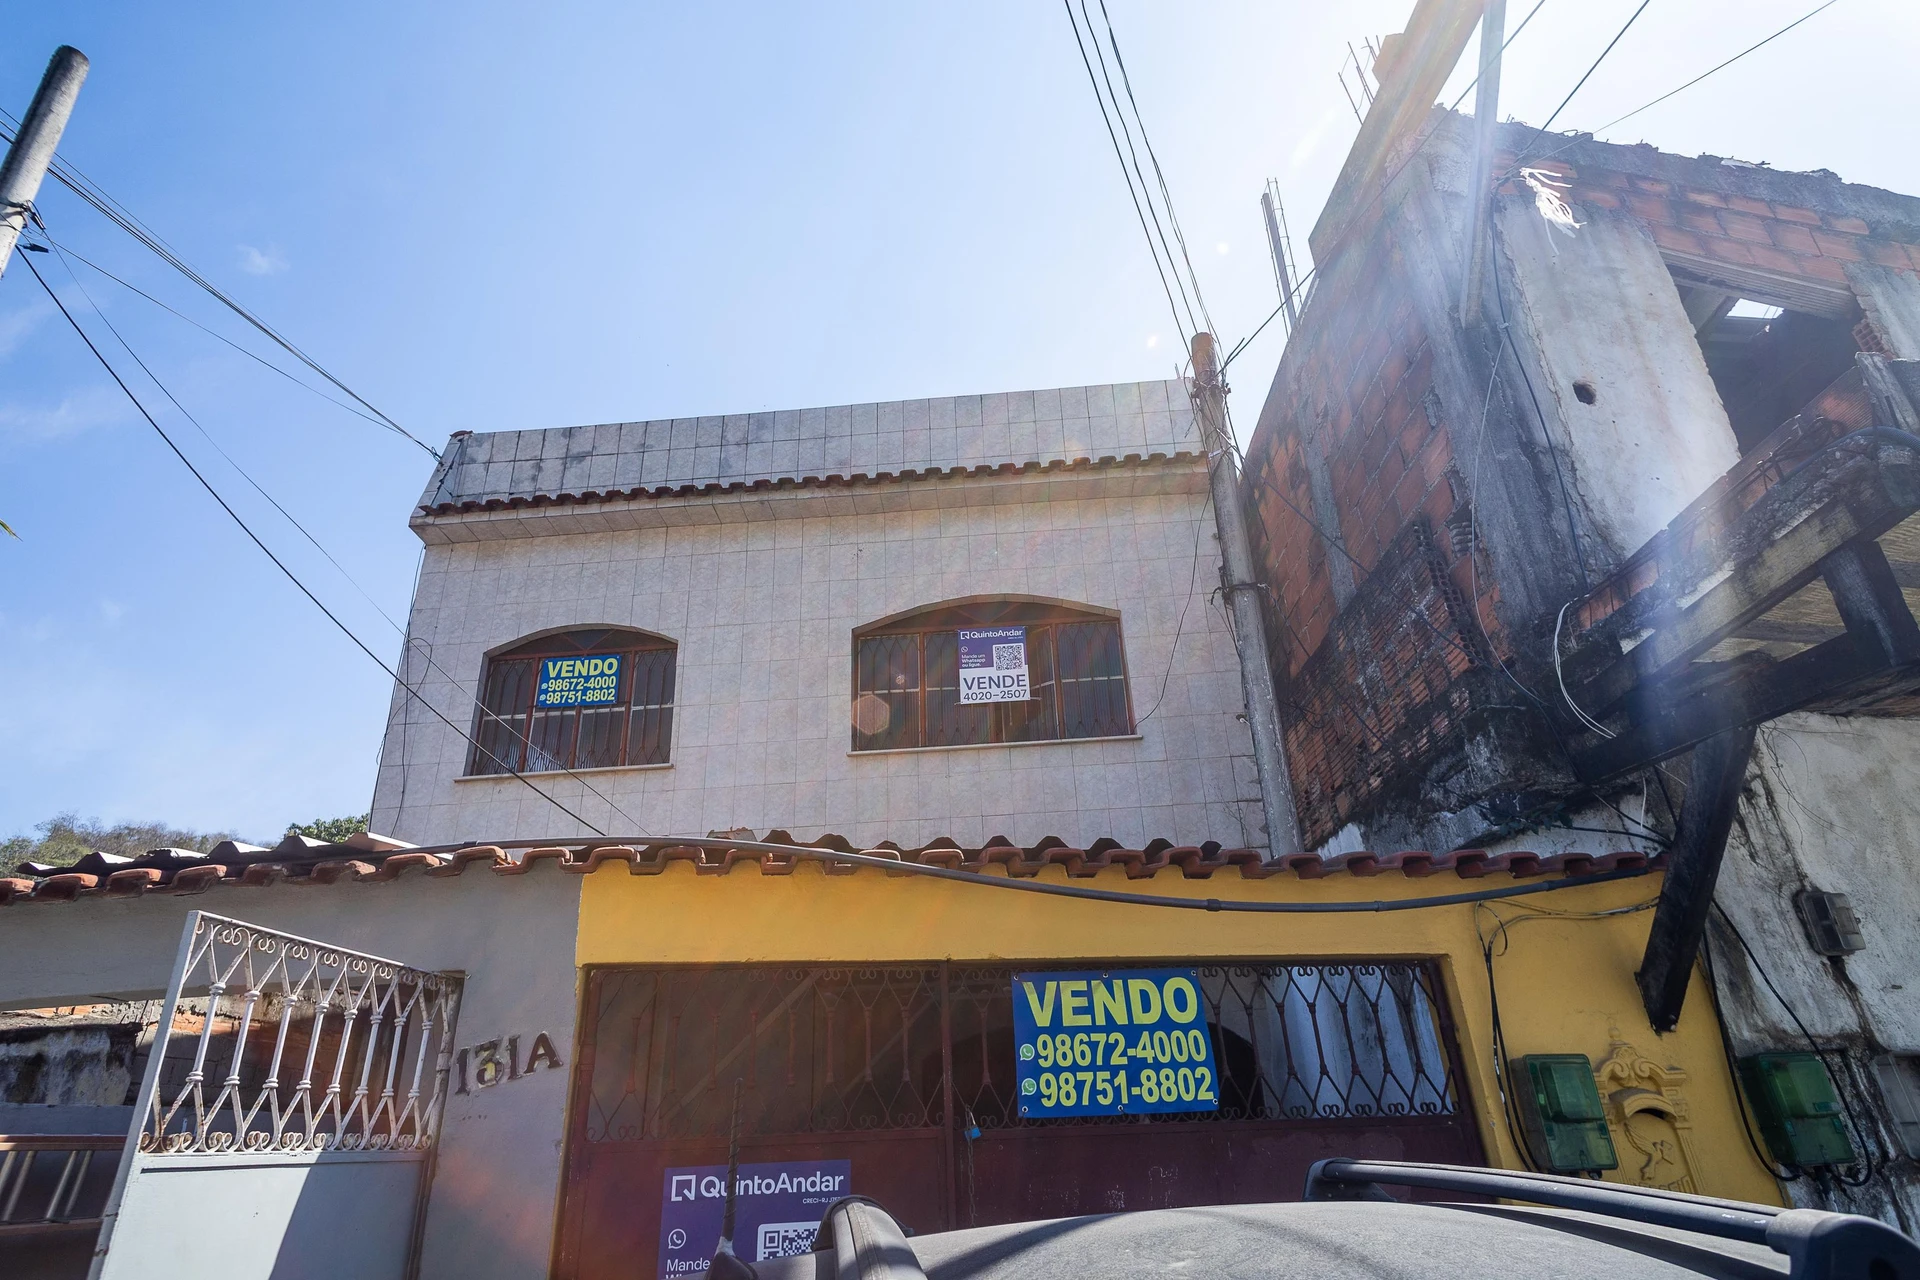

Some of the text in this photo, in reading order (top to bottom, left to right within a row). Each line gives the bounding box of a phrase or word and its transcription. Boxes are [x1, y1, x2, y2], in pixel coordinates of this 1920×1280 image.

[970, 629, 1022, 638] QuintoAndar
[547, 658, 618, 678] VENDO
[547, 676, 616, 691] 98672-4000
[963, 674, 1027, 690] VENDE
[546, 688, 615, 704] 98751-8802
[963, 689, 1027, 701] 4020-2507
[1022, 976, 1198, 1027] VENDO
[1036, 1029, 1207, 1068] 98672-4000
[455, 1031, 564, 1096] 131A
[1039, 1066, 1214, 1107] 98751-8802
[666, 1257, 711, 1272] Mande
